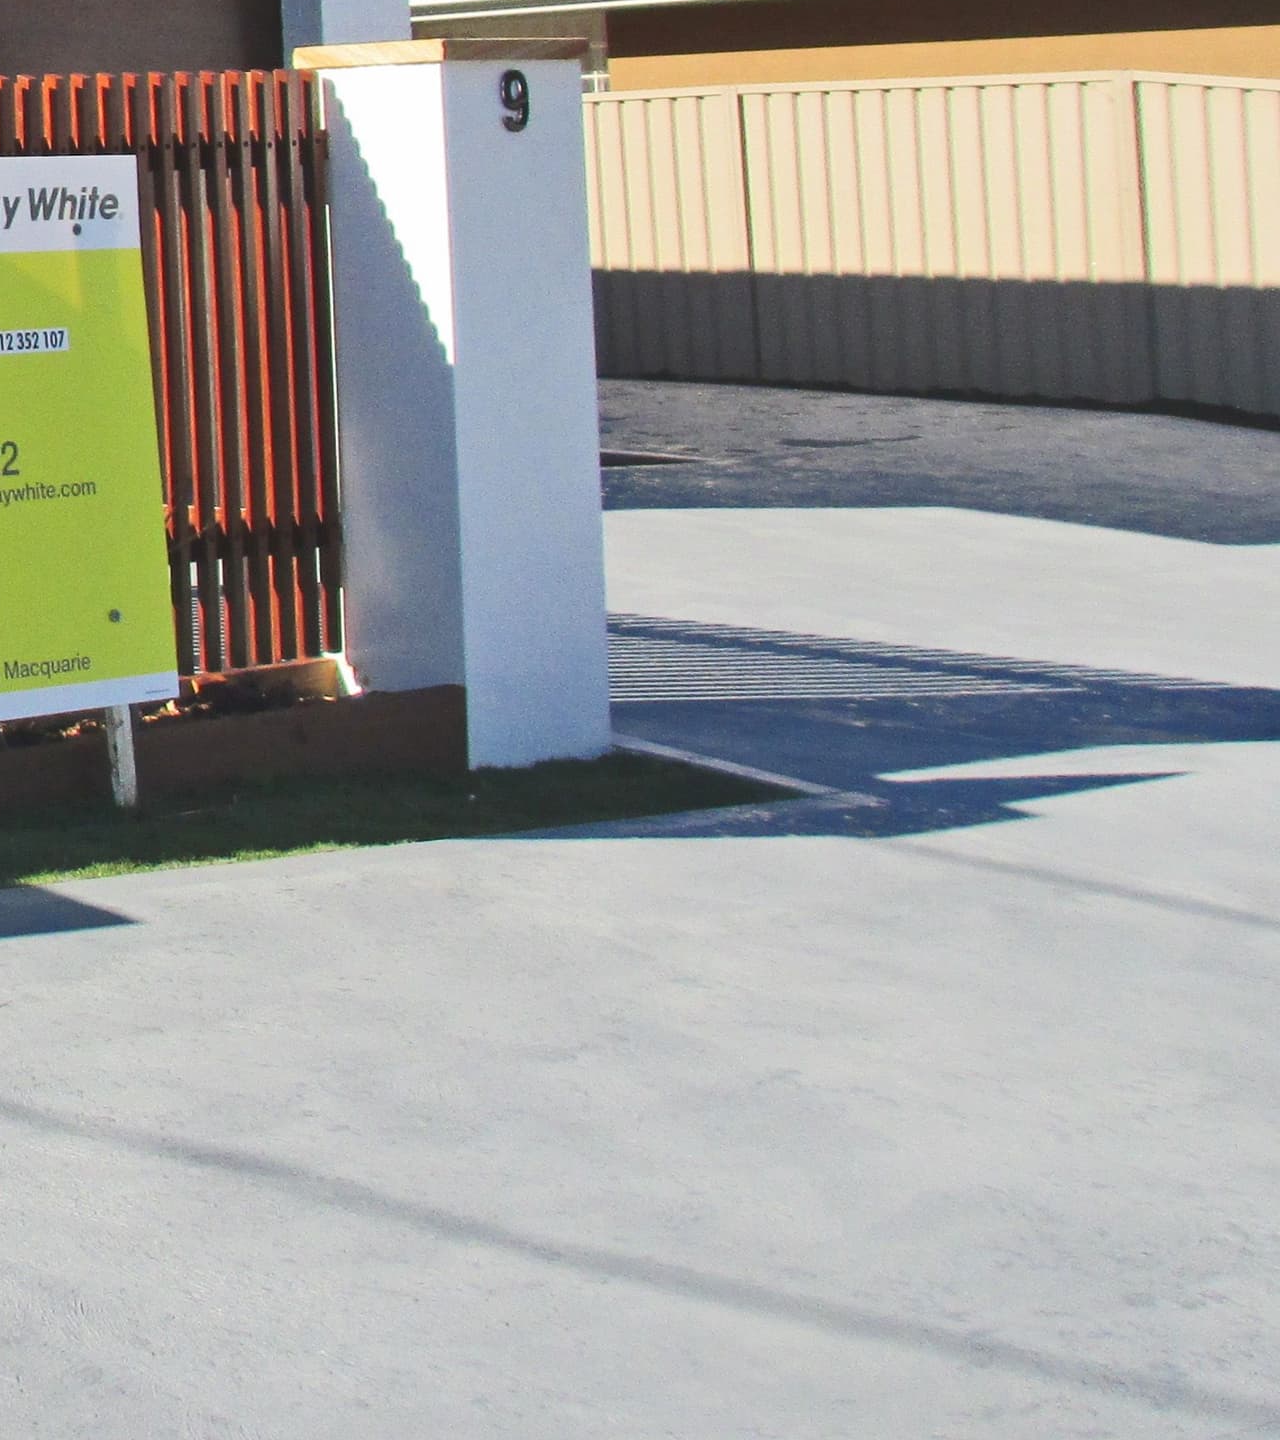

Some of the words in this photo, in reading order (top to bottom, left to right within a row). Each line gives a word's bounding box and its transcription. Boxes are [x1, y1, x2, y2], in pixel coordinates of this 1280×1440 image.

[501, 69, 529, 132] 9
[28, 186, 119, 221] White
[17, 331, 40, 351] 352
[43, 330, 65, 349] 107
[4, 653, 91, 681] Macquarie
